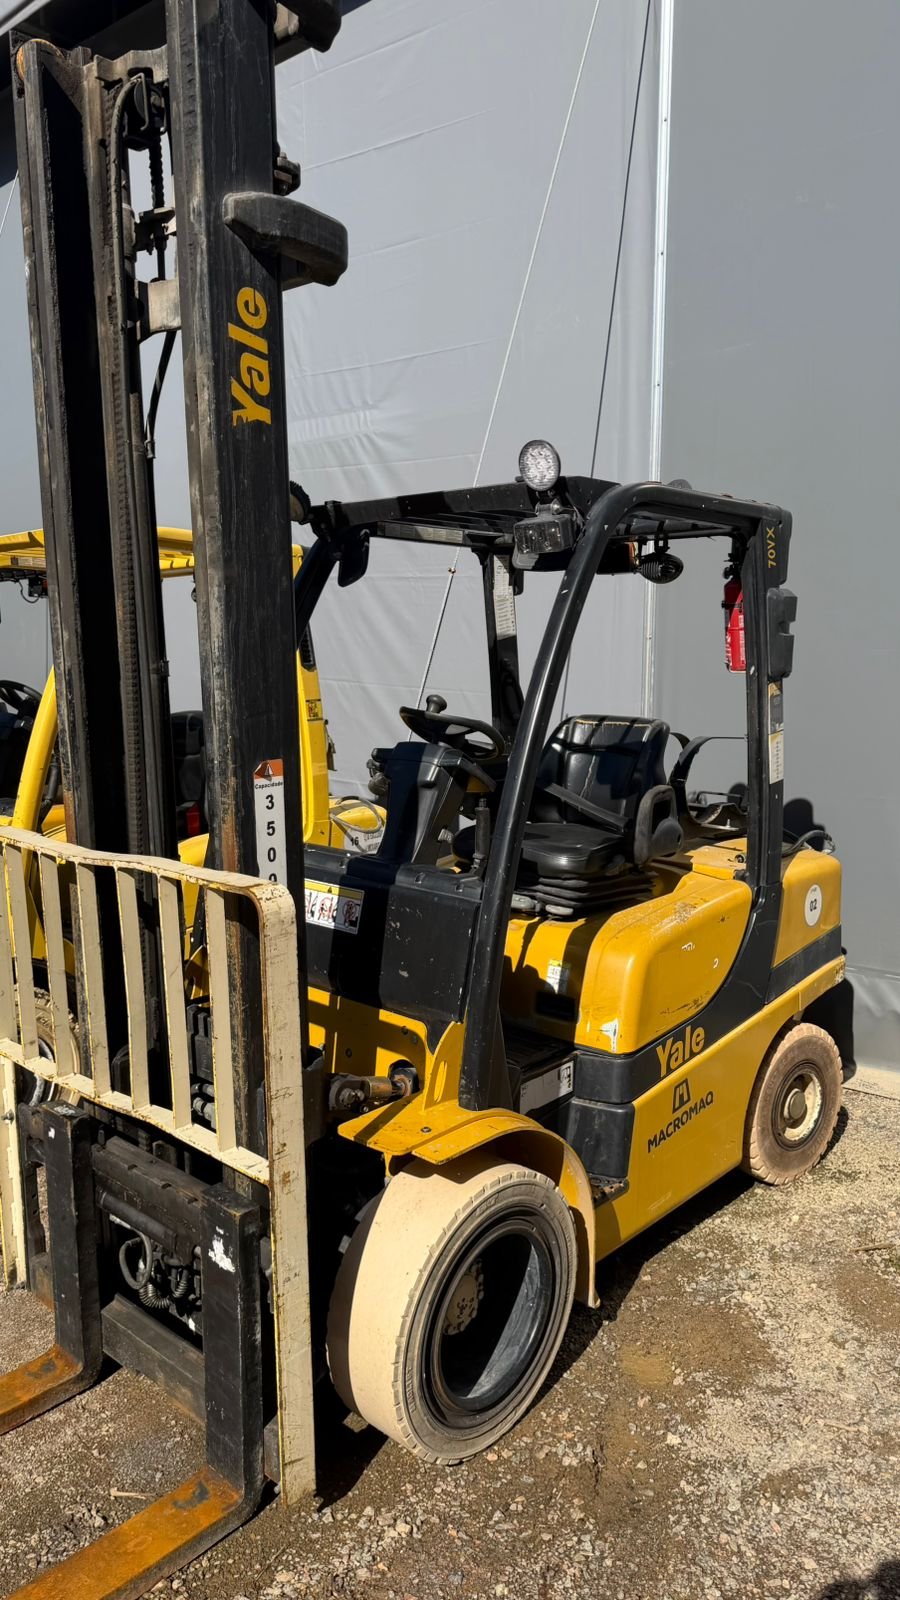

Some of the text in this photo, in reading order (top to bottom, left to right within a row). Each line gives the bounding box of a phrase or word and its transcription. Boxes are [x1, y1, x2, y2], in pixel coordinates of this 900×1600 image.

[227, 286, 272, 427] Yale
[766, 526, 777, 569] 70VX
[254, 780, 284, 790] Capacidade
[810, 898, 818, 912] 02
[656, 1025, 705, 1078] Yale
[647, 1090, 715, 1154] MACROMAQ
